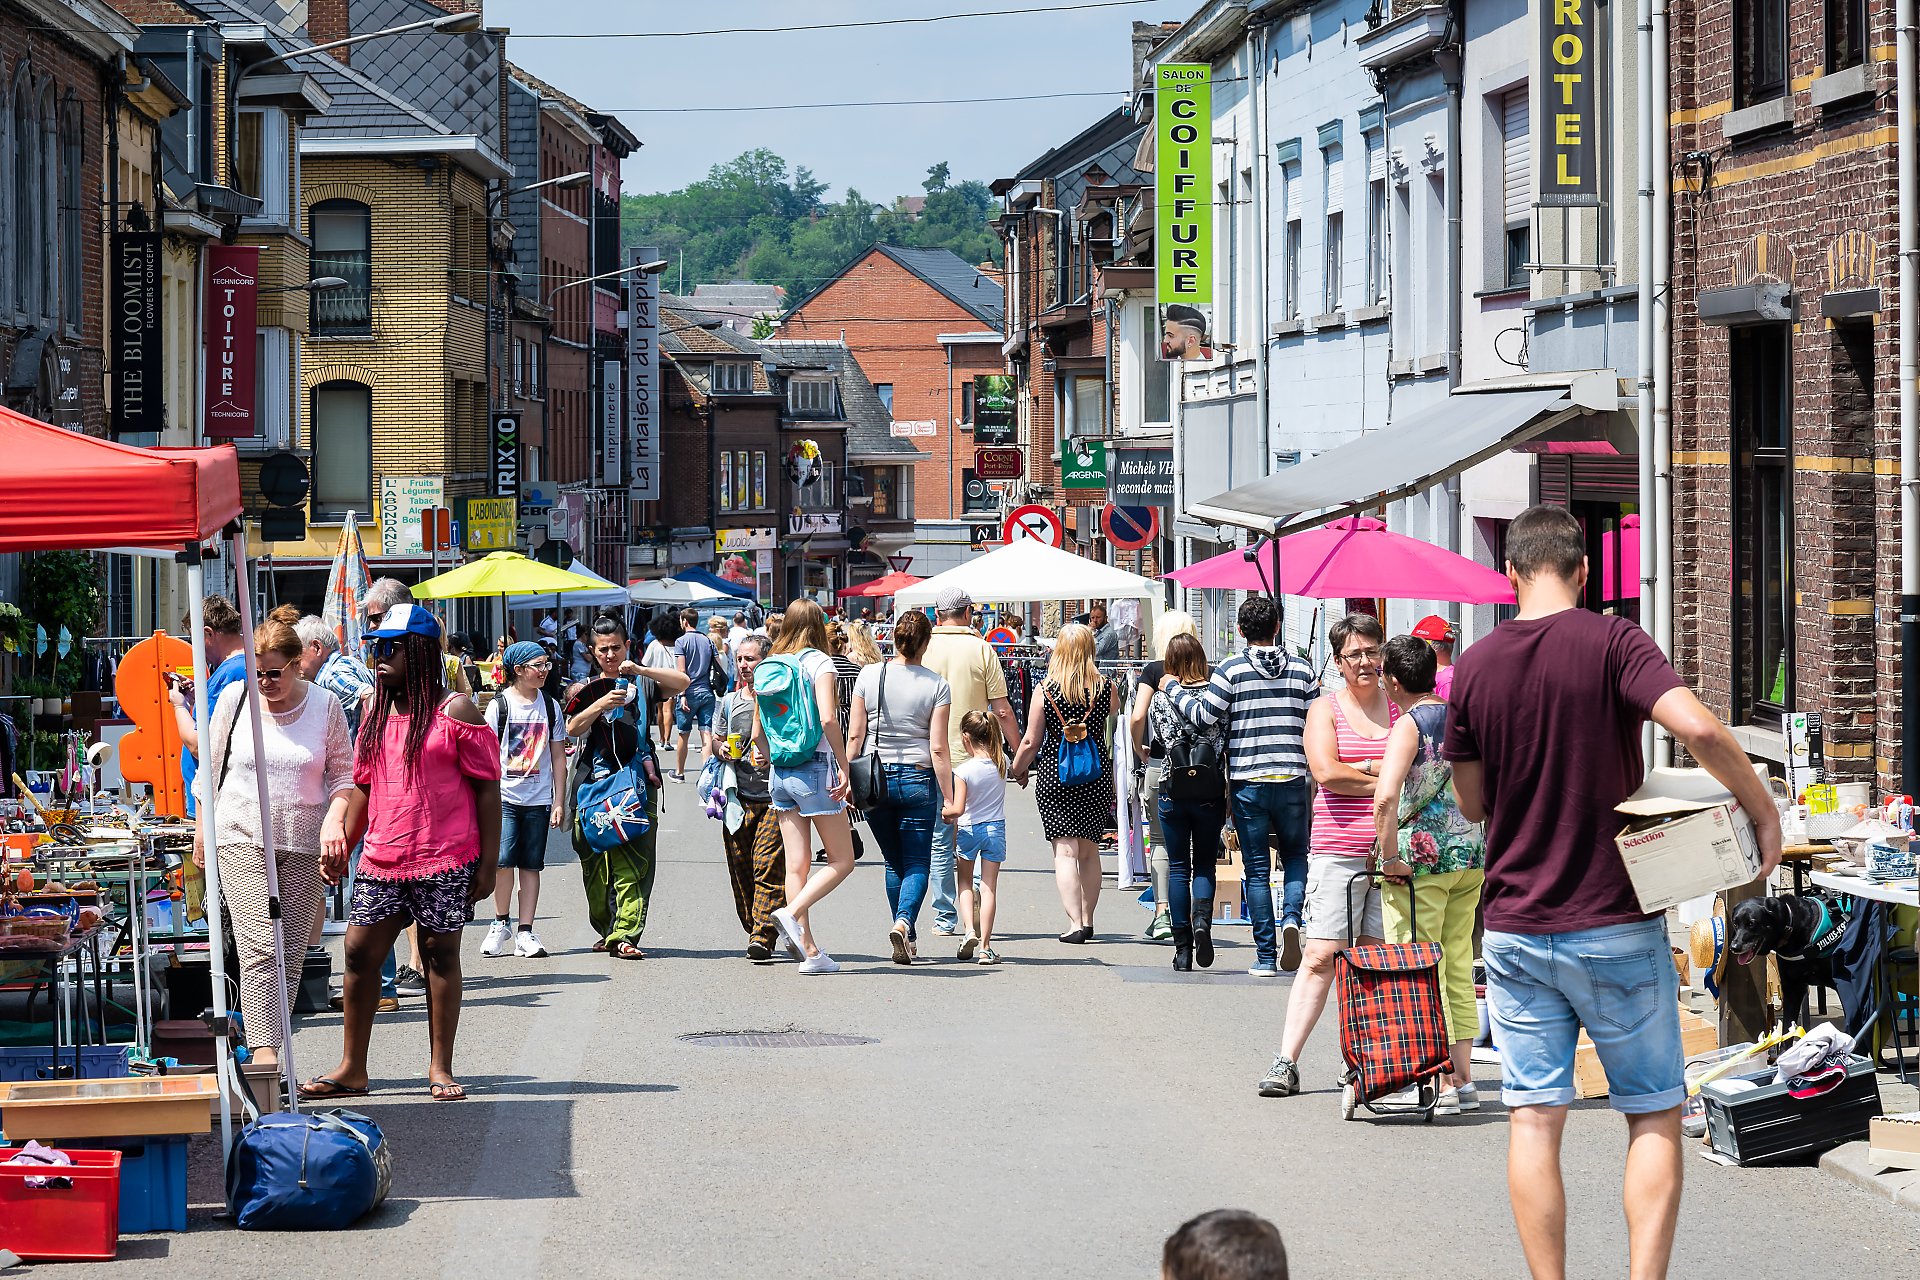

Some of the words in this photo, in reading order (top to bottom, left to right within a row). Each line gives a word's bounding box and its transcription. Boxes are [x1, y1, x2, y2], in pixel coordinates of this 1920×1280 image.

[1162, 70, 1204, 80] SALON
[1175, 84, 1192, 93] DE
[1552, 0, 1584, 185] ROTEL
[1170, 99, 1200, 294] COIFFURE
[146, 242, 155, 284] CONCEPT
[212, 278, 255, 286] TECHNICORD
[123, 242, 143, 362] BLOOMIST
[146, 286, 155, 329] FLOWERS
[632, 256, 656, 329] papier
[222, 289, 235, 396] TOITURE
[632, 338, 650, 367] du
[123, 370, 143, 419] THE
[632, 374, 650, 457] maison
[606, 382, 619, 464] imprimerie
[497, 418, 516, 496] TRIXXO
[1064, 471, 1107, 480] ARGENTA
[1119, 460, 1157, 475] Michèle
[402, 487, 441, 496] Légumes
[632, 466, 650, 491] La
[1116, 480, 1152, 494] seconde
[384, 480, 398, 555] L'ABONDANCE
[409, 497, 434, 505] Tabac
[1622, 830, 1665, 850] Sélection
